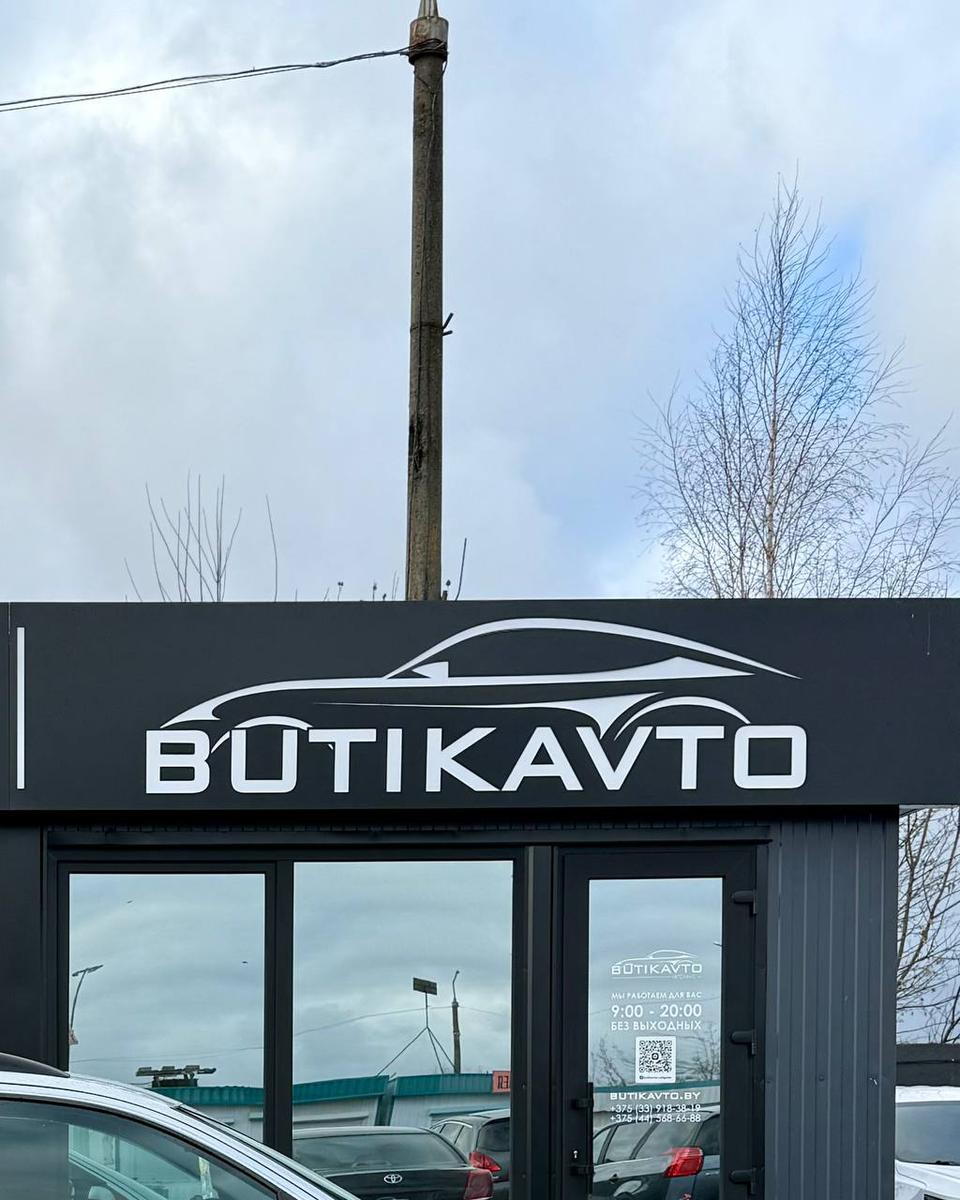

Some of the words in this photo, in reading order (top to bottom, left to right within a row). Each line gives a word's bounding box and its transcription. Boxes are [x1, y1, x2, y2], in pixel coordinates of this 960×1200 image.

[145, 725, 807, 794] BUTIKAVTO
[611, 963, 703, 975] BUTIKAVTO
[611, 991, 625, 1000] МЫ
[627, 991, 667, 1000] РАБОТАЕМ
[669, 991, 685, 1000] ДЛЯ
[686, 991, 703, 1000] ВАС
[611, 1004, 644, 1018] 9:00
[659, 1004, 702, 1017] 20:00
[611, 1020, 630, 1032] БЕЗ
[633, 1020, 702, 1032] ВЫХОДНЫХ
[610, 1091, 701, 1100] BUTIKAVTO.BY
[610, 1104, 633, 1113] +375
[635, 1104, 653, 1114] (33)
[656, 1103, 701, 1113] 918-38-19
[610, 1114, 633, 1123] +375
[635, 1114, 653, 1124] (44)
[655, 1113, 701, 1123] 568-66-88
